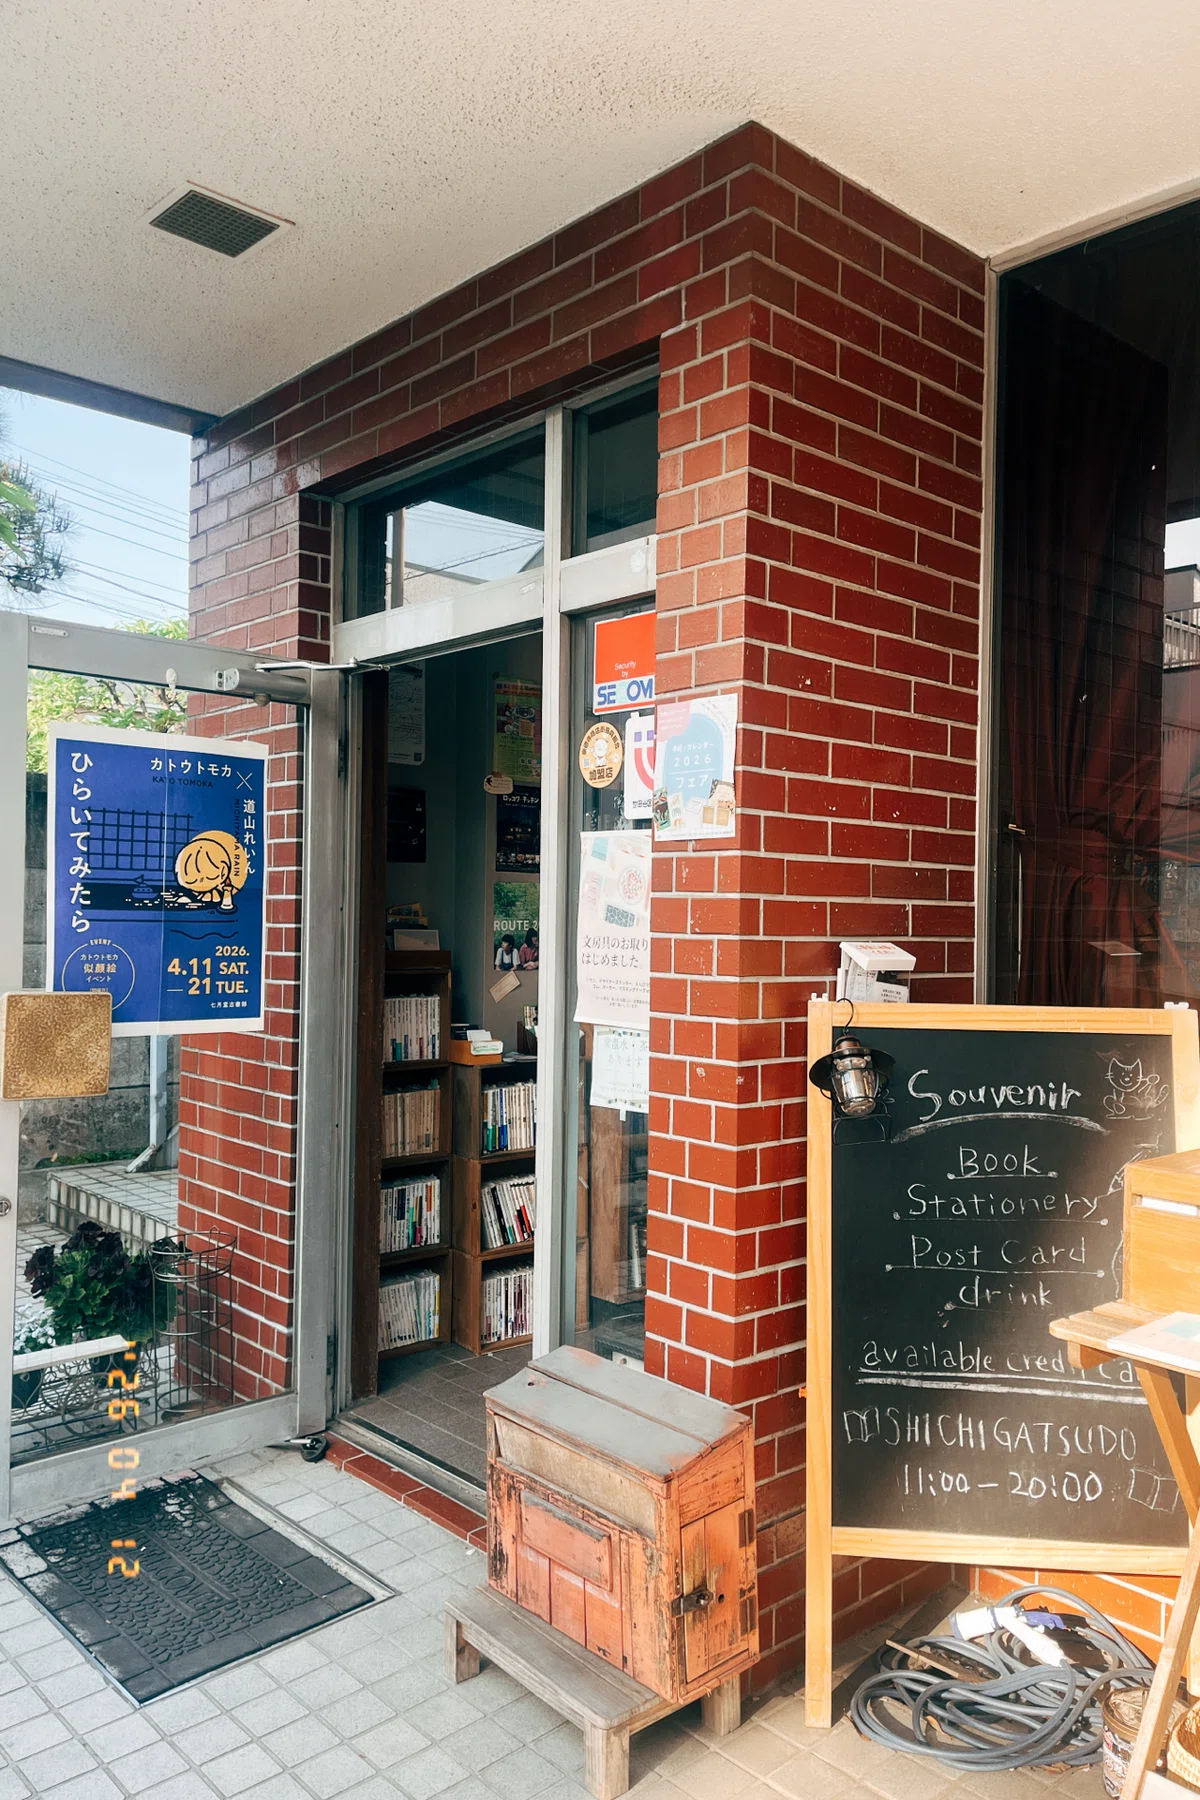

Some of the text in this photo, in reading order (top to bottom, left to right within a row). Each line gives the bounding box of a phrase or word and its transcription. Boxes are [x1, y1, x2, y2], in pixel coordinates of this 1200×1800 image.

[614, 660, 637, 672] Security
[597, 678, 653, 706] SECOM
[150, 757, 232, 778] カトウトモカ
[674, 753, 712, 768] 2026
[178, 778, 213, 788] TOMOKA
[588, 766, 613, 782] 加盟店
[675, 774, 710, 789] フェア
[233, 798, 241, 851] MICHIYAMA
[69, 752, 94, 934] ひらいてみたら
[243, 798, 257, 875] 道山れいん
[494, 920, 529, 931] ROUTE
[89, 938, 112, 946] EVENT
[215, 945, 250, 957] 2026.
[583, 935, 649, 951] 文房具のお取り
[80, 953, 119, 961] カトウトモカ
[581, 953, 643, 969] はじめました。
[83, 963, 117, 974] 似顔絵
[167, 957, 249, 976] 4.11 SAT.
[85, 975, 112, 983] イベント
[188, 977, 211, 995] 21
[215, 981, 249, 994] TUE.
[907, 1069, 1083, 1121] Souvenir
[959, 1144, 1042, 1177] Book
[907, 1183, 1101, 1219] Stationery
[910, 1234, 1086, 1269] Post Card
[959, 1275, 1052, 1307] drink
[863, 1340, 996, 1372] available
[885, 1407, 1137, 1461] SHICHIGATSUDO
[904, 1464, 970, 1497] 11:00
[1008, 1471, 1103, 1502] 20:00
